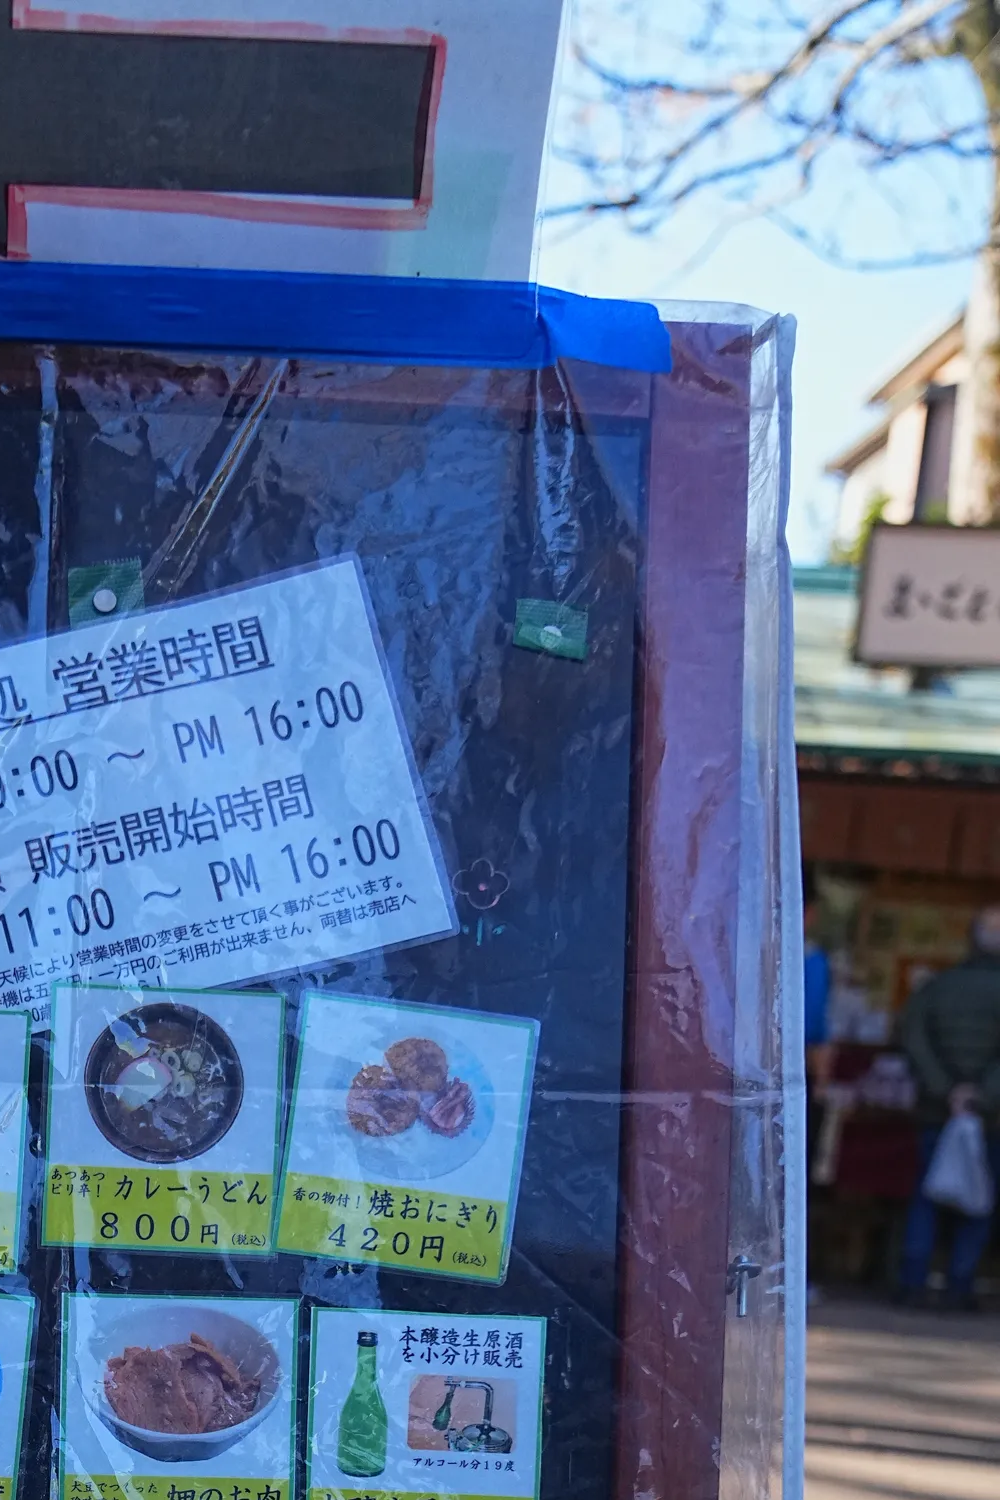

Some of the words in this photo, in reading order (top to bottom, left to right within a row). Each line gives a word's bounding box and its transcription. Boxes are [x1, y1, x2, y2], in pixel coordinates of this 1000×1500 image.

[52, 616, 271, 711] 営業時間
[173, 715, 223, 763] PM
[245, 681, 365, 744] 16:00
[27, 774, 314, 884] 販売開始時間
[210, 855, 261, 903] PM
[280, 819, 401, 886] 16:00
[51, 1168, 105, 1182] あつあつ
[114, 1174, 267, 1205] カレーうどん
[101, 1212, 218, 1245] 800円
[231, 1233, 267, 1246] (税込)
[293, 1187, 361, 1209] 香の物付！
[368, 1190, 498, 1234] 焼おにぎり
[328, 1223, 445, 1263] 420円
[452, 1253, 487, 1267] (税込)
[399, 1326, 524, 1350] 本醸造生原酒
[402, 1346, 524, 1369] を小分け販売
